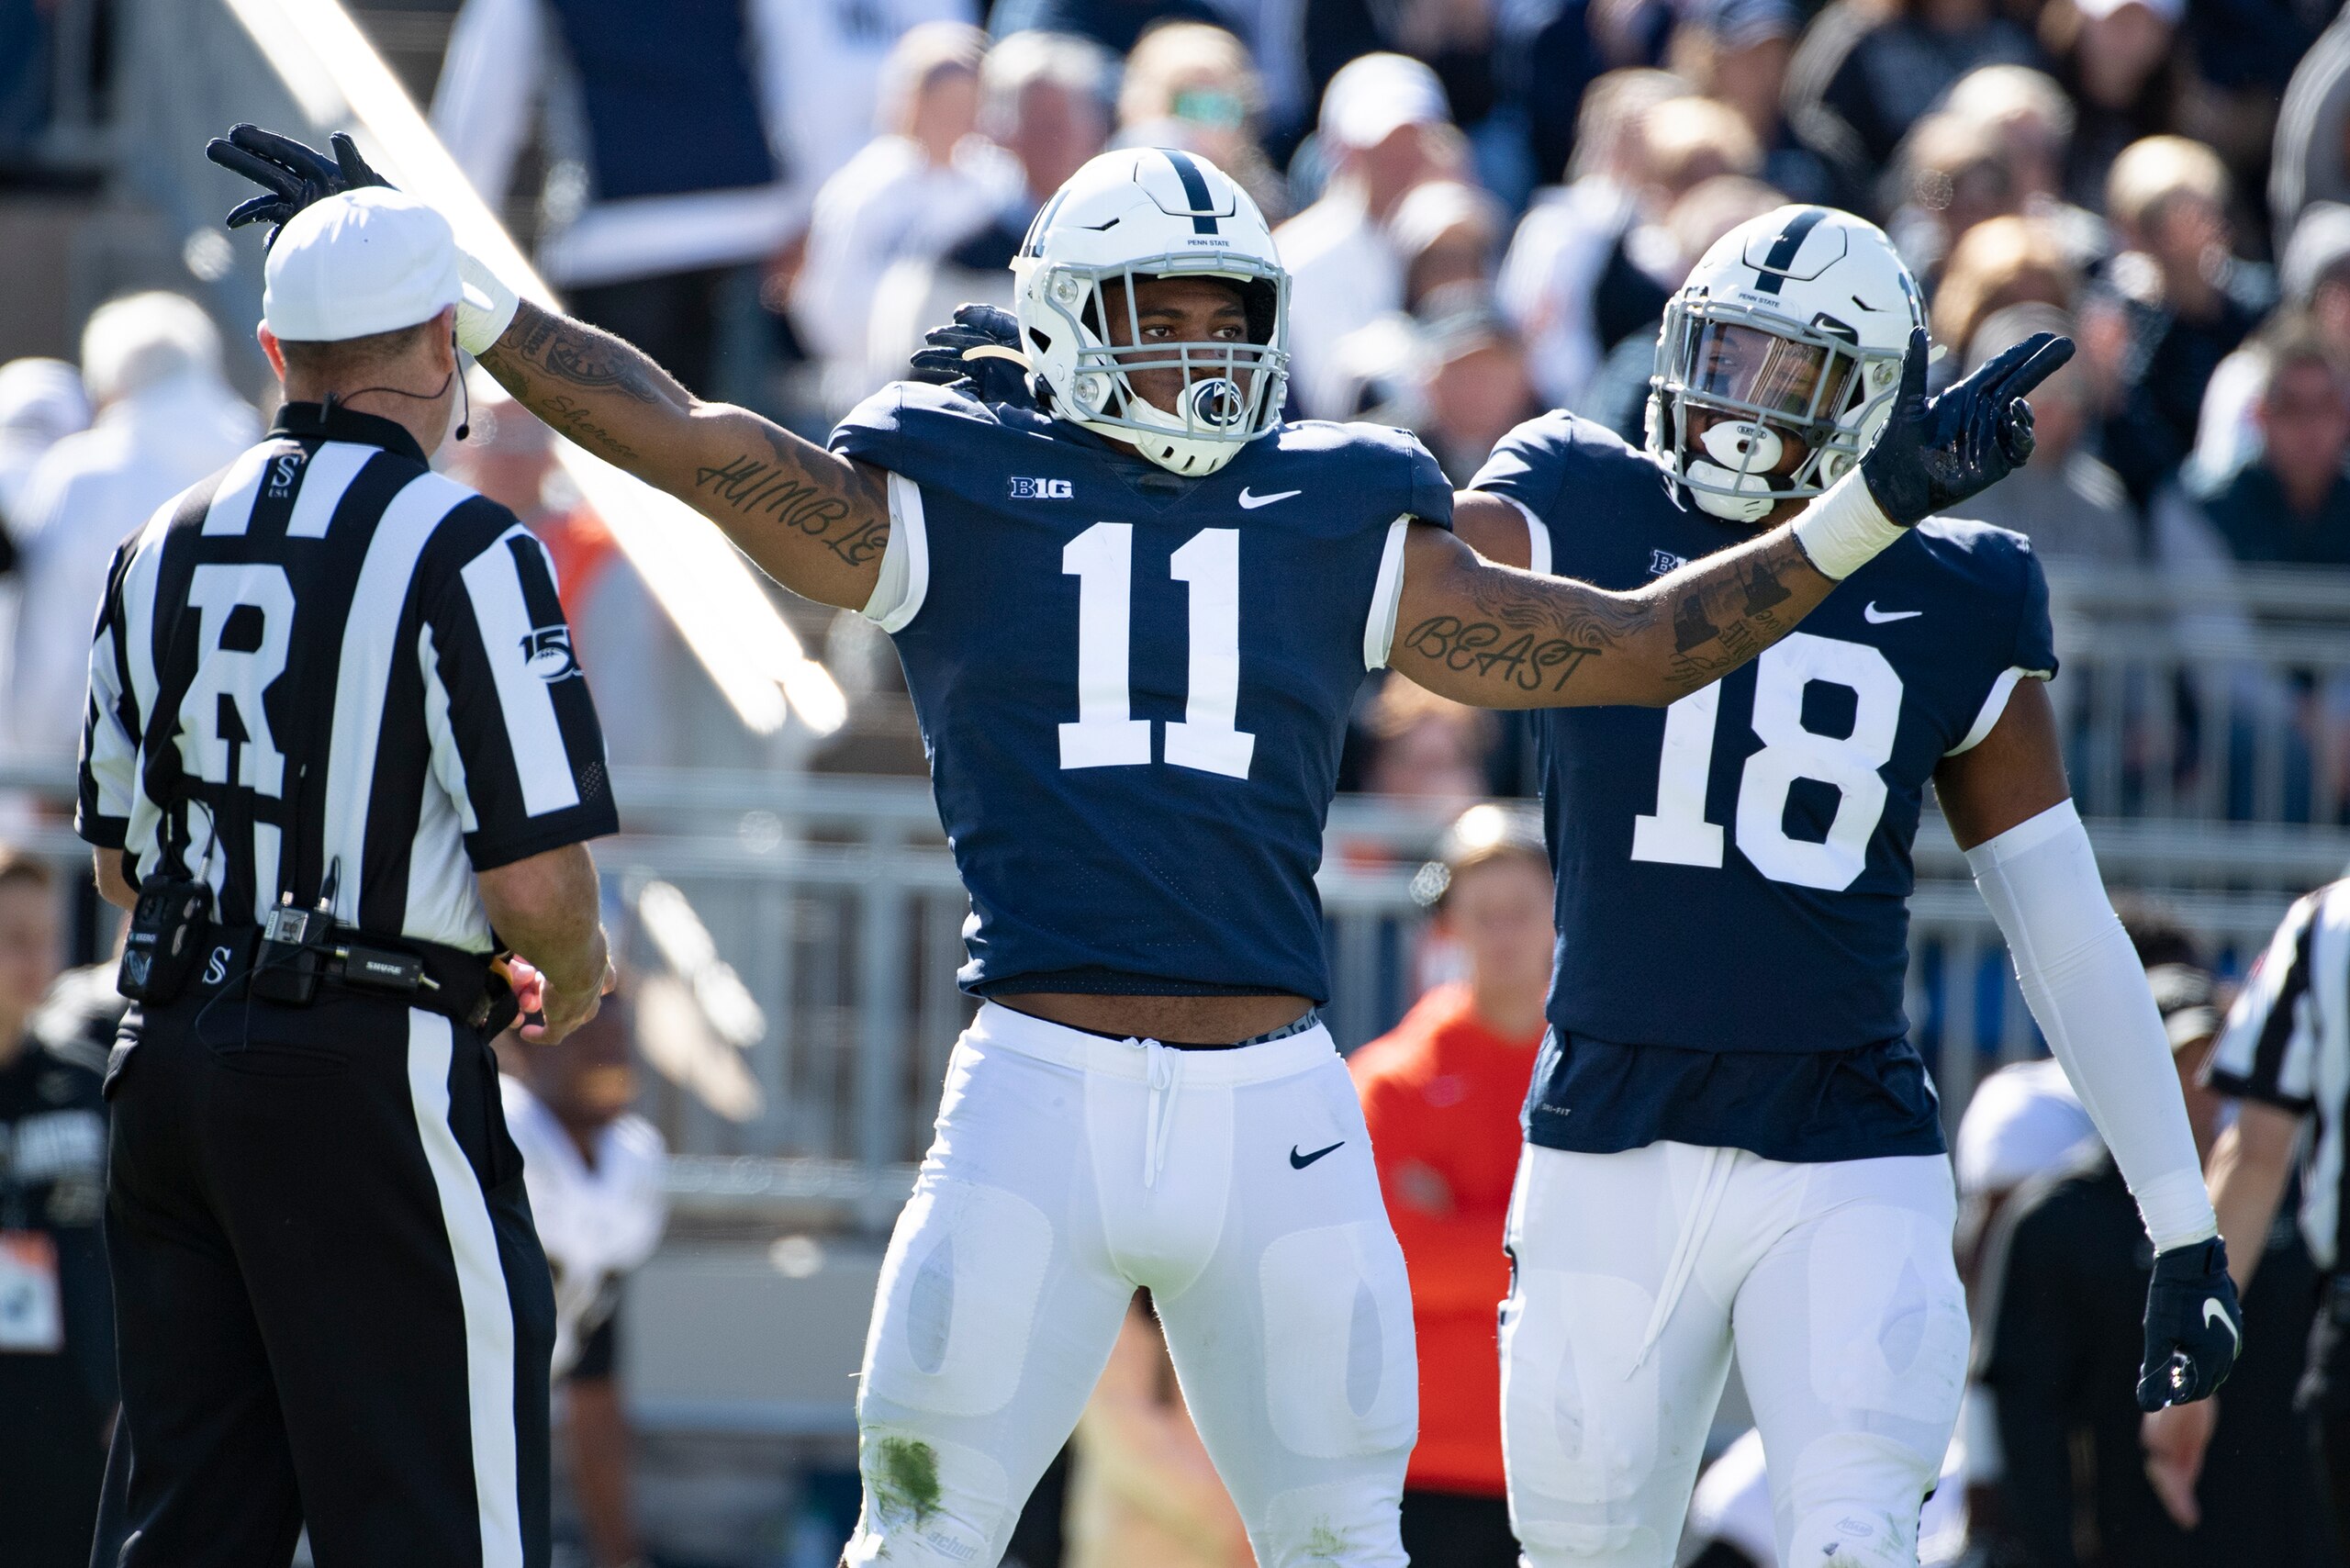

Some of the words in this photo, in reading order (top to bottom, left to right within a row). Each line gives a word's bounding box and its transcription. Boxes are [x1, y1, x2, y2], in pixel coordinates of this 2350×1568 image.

[1738, 293, 1757, 302] PENN
[1758, 297, 1780, 308] STATE
[172, 563, 297, 801] R
[1058, 521, 1256, 780] 11
[1404, 615, 1602, 692] BEAST
[1630, 631, 1905, 892] 18
[366, 961, 403, 975] SHURE
